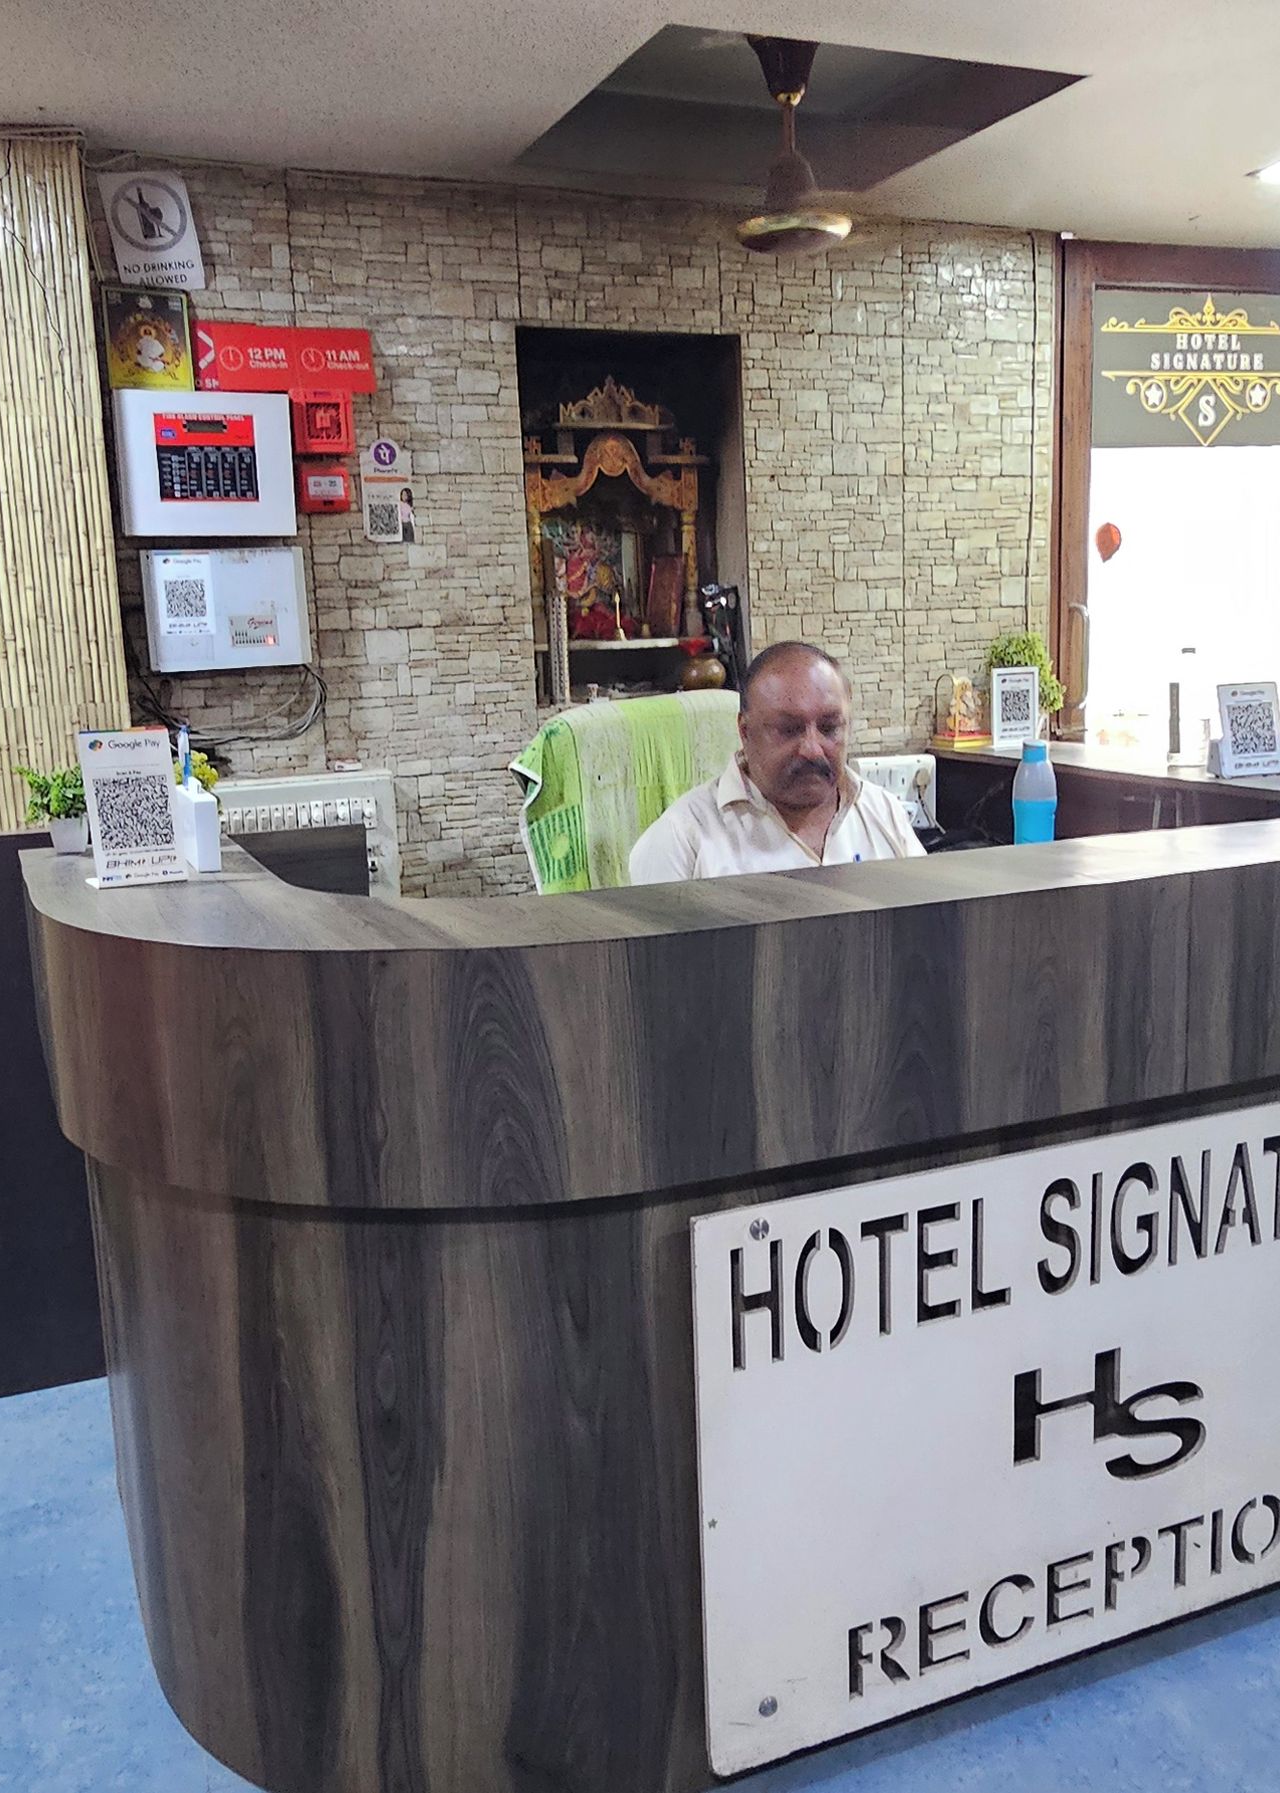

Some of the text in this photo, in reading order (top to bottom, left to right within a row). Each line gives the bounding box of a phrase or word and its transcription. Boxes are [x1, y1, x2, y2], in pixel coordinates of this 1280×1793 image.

[123, 260, 195, 274] NO DRINKING
[140, 273, 188, 286] ALLOWED
[1175, 333, 1241, 350] HOTEL
[248, 347, 286, 360] 12 PM
[325, 349, 360, 361] 11 AM
[249, 360, 288, 369] Check-in
[1150, 353, 1264, 371] SIGNATURE
[1198, 394, 1217, 427] S
[108, 738, 160, 750] Google Pay
[730, 1198, 1011, 1373] HOTEL
